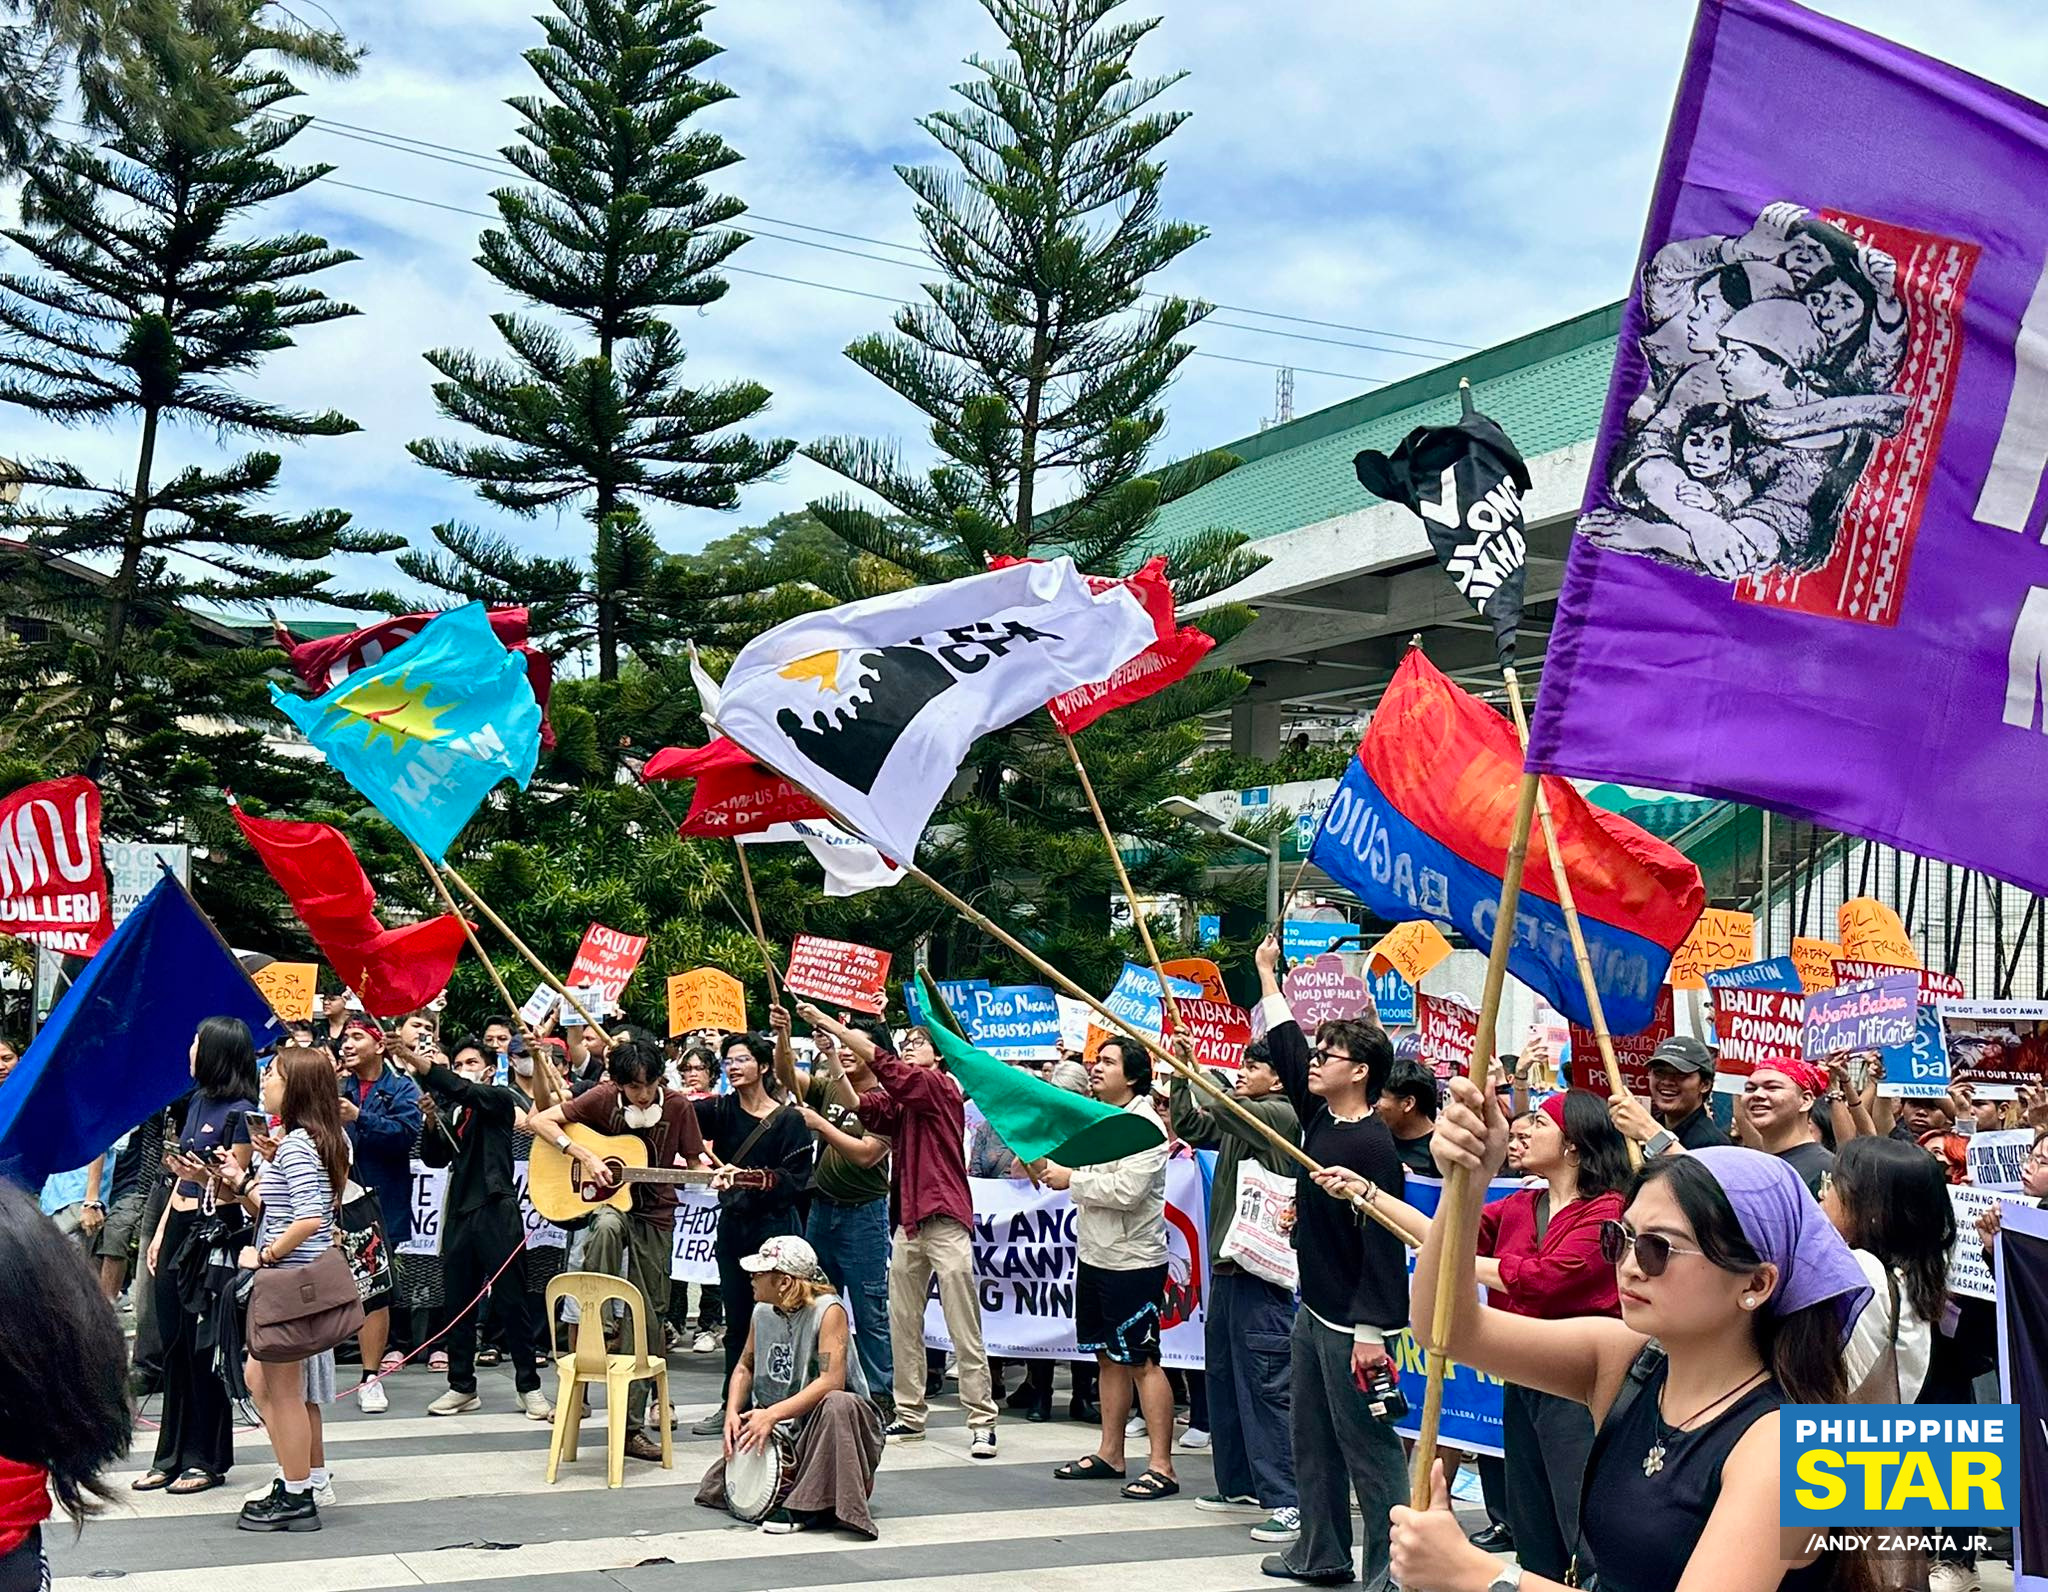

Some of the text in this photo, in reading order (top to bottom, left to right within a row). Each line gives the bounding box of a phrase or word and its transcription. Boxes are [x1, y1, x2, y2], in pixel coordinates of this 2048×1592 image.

[586, 924, 643, 957] ISAULI
[792, 965, 806, 975] SA
[854, 955, 879, 969] PERO
[1294, 972, 1345, 987] WOMEN
[974, 990, 1013, 1017] PURO
[1294, 989, 1362, 1001] HOLD UP HALF
[1719, 989, 1775, 1017] IBALIK
[1302, 1006, 1345, 1024] SKY
[1983, 1007, 1998, 1015] SHE
[2000, 1007, 2017, 1015] GOT
[2019, 1007, 2044, 1015] AWAY
[1190, 1020, 1225, 1040] WAG
[1161, 1033, 1248, 1066] MTAKOT!
[1959, 1068, 1985, 1078] WITH
[1986, 1071, 2008, 1080] OUR
[1978, 1146, 1998, 1166] OUR
[1977, 1164, 2002, 1184] FLOW
[1954, 1190, 1980, 1204] KABAN
[1982, 1196, 1993, 1206] NG
